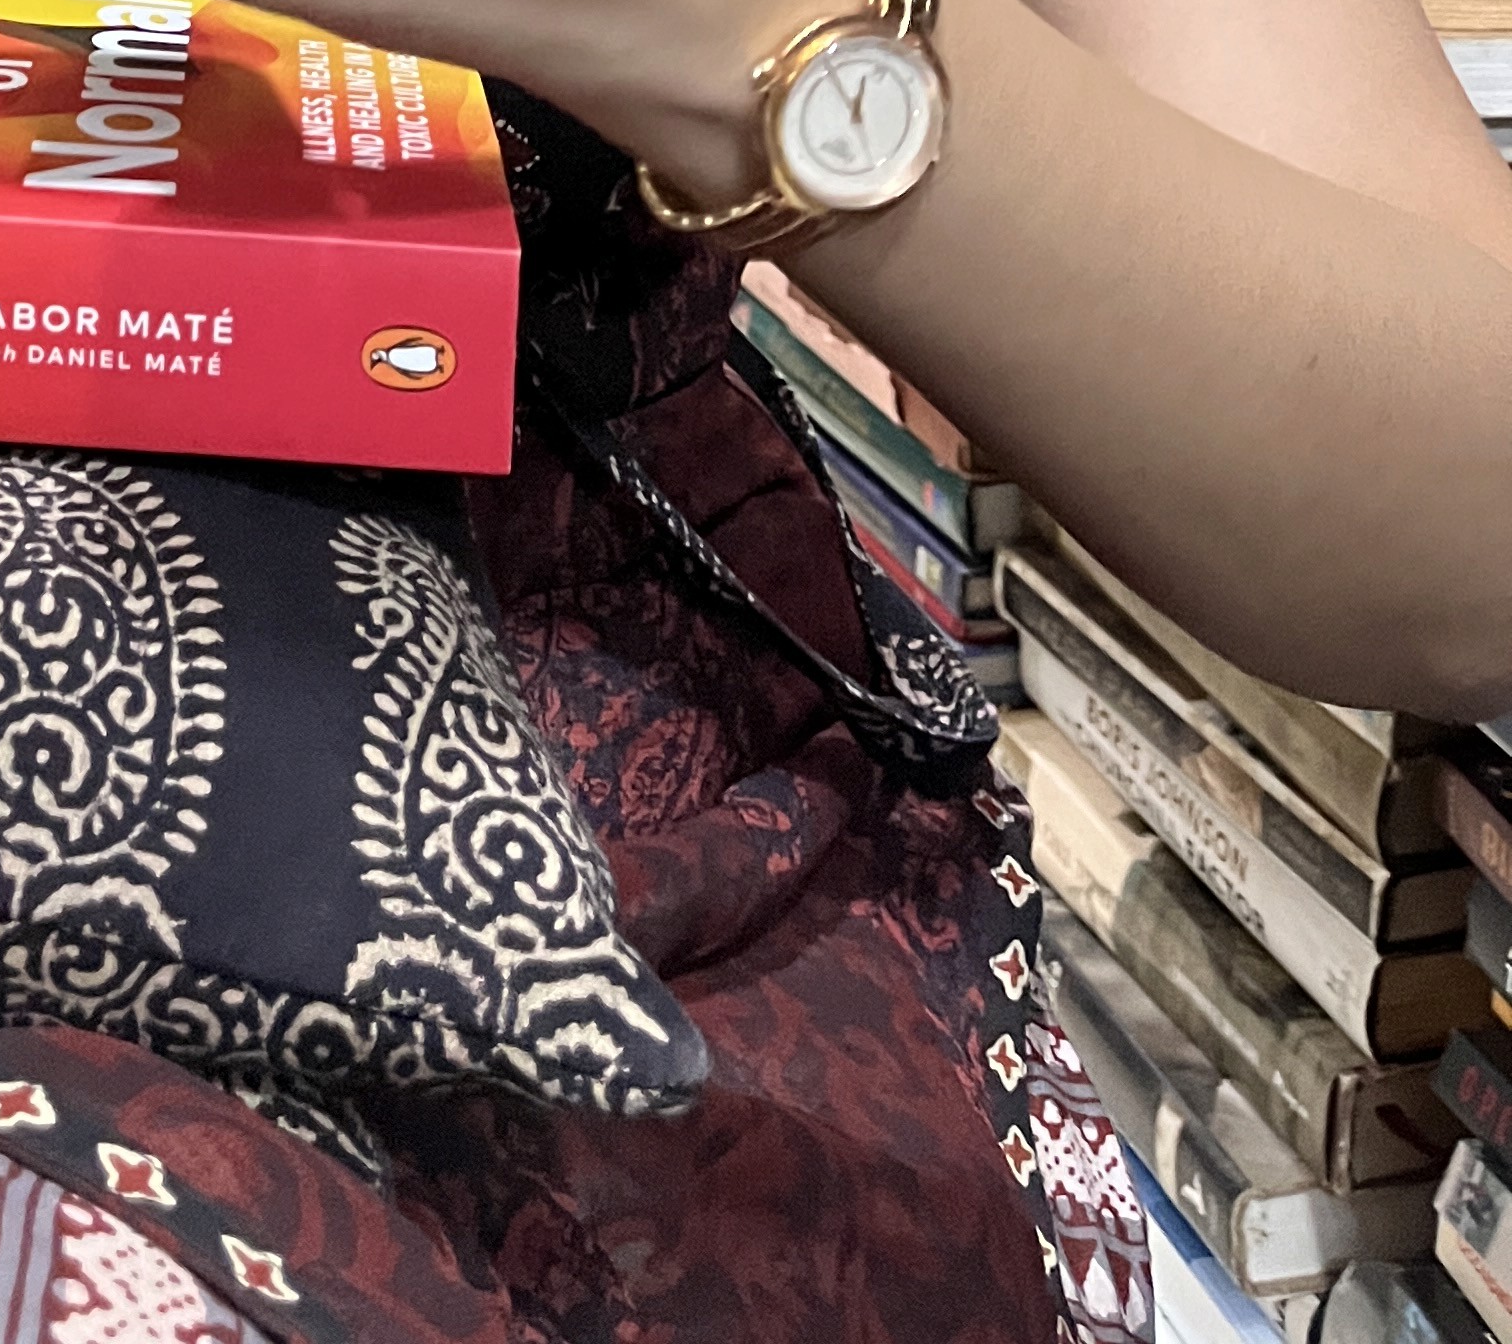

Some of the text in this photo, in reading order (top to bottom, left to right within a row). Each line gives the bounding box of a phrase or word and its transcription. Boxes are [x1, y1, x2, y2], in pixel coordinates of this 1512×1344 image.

[298, 39, 339, 162] ILLNESS, HEALTH
[344, 68, 382, 131] HEALING
[386, 52, 435, 161] TOXIC CULTURE
[350, 132, 387, 172] AND
[118, 307, 235, 346] MATÉ
[27, 344, 132, 371] DANIEL
[144, 351, 222, 377] MATÉ
[1085, 693, 1142, 771] BORIS
[1145, 767, 1250, 883] JOHNSON
